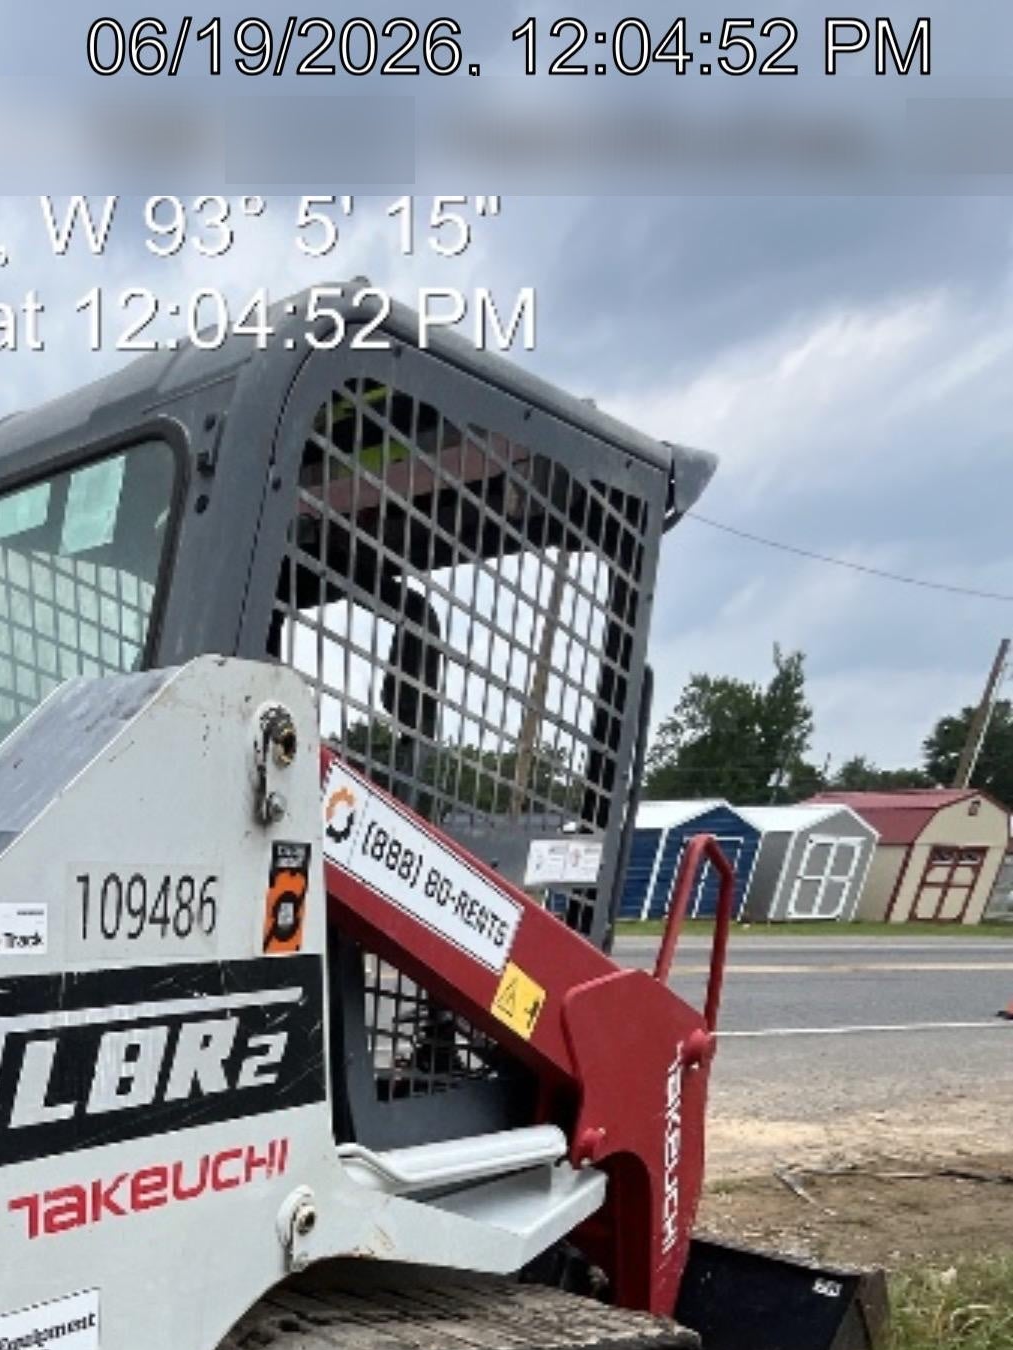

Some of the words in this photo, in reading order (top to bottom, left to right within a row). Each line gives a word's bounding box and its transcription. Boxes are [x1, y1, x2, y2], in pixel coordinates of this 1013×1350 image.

[76, 872, 219, 940] 109486
[361, 820, 424, 889] (888)
[424, 866, 509, 947] 80-RENTS
[8, 1137, 290, 1240] TAKEUCHI
